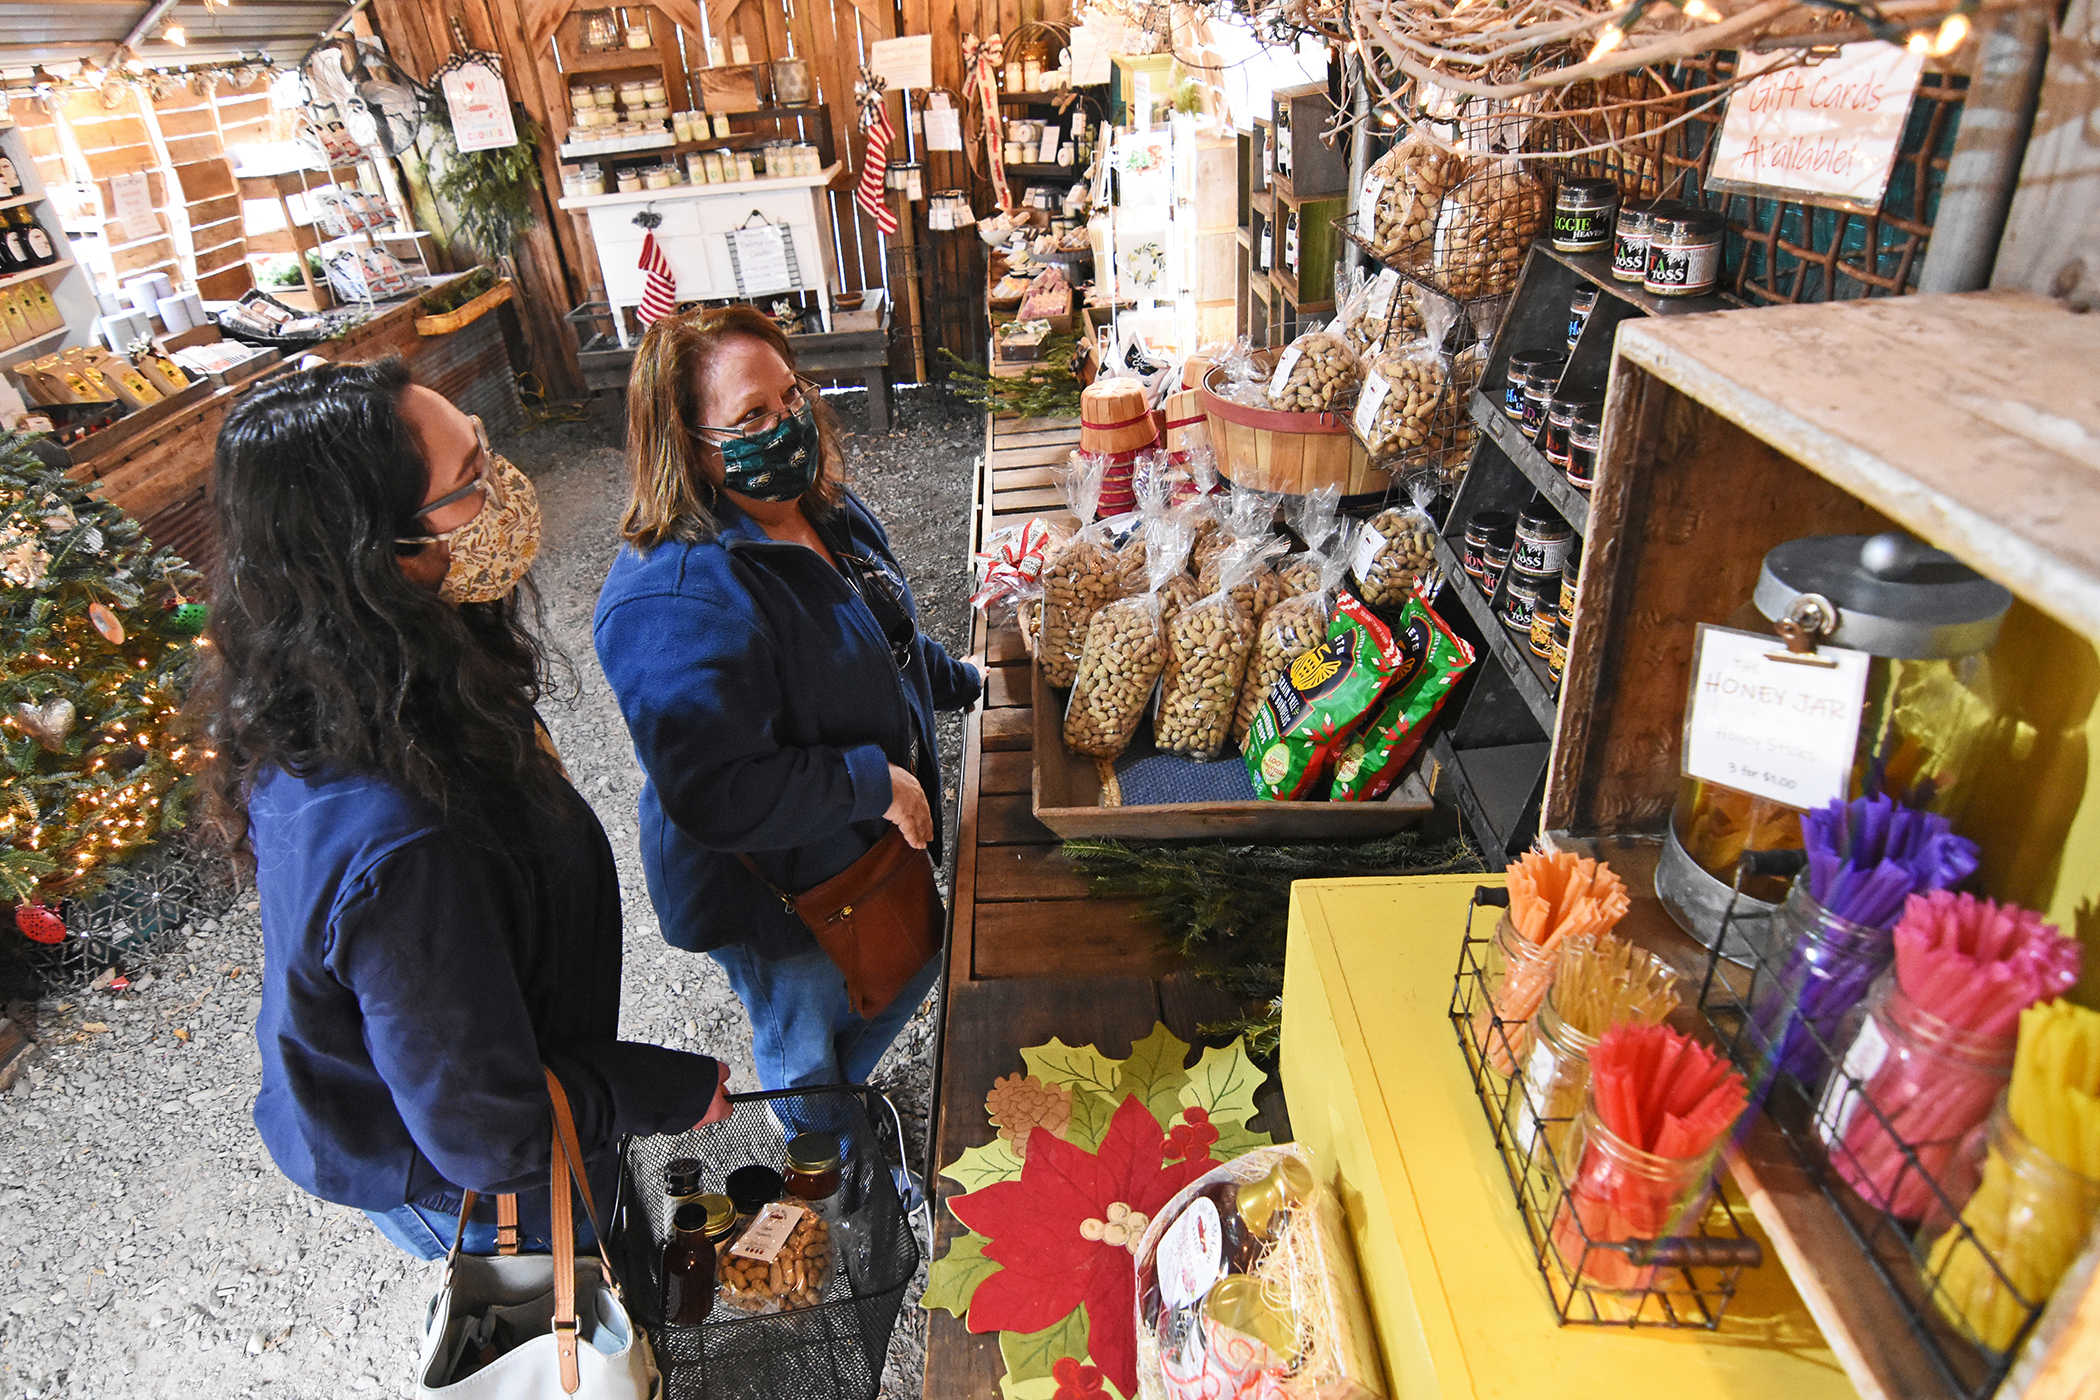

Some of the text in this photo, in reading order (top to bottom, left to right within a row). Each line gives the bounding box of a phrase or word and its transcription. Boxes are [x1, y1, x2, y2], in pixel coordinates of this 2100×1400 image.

[1749, 69, 1884, 113] Gift Cards
[1741, 135, 1856, 177] Available!
[1705, 673, 1846, 720] HONEY JAR
[1728, 762, 1798, 790] 3 for $1.00
